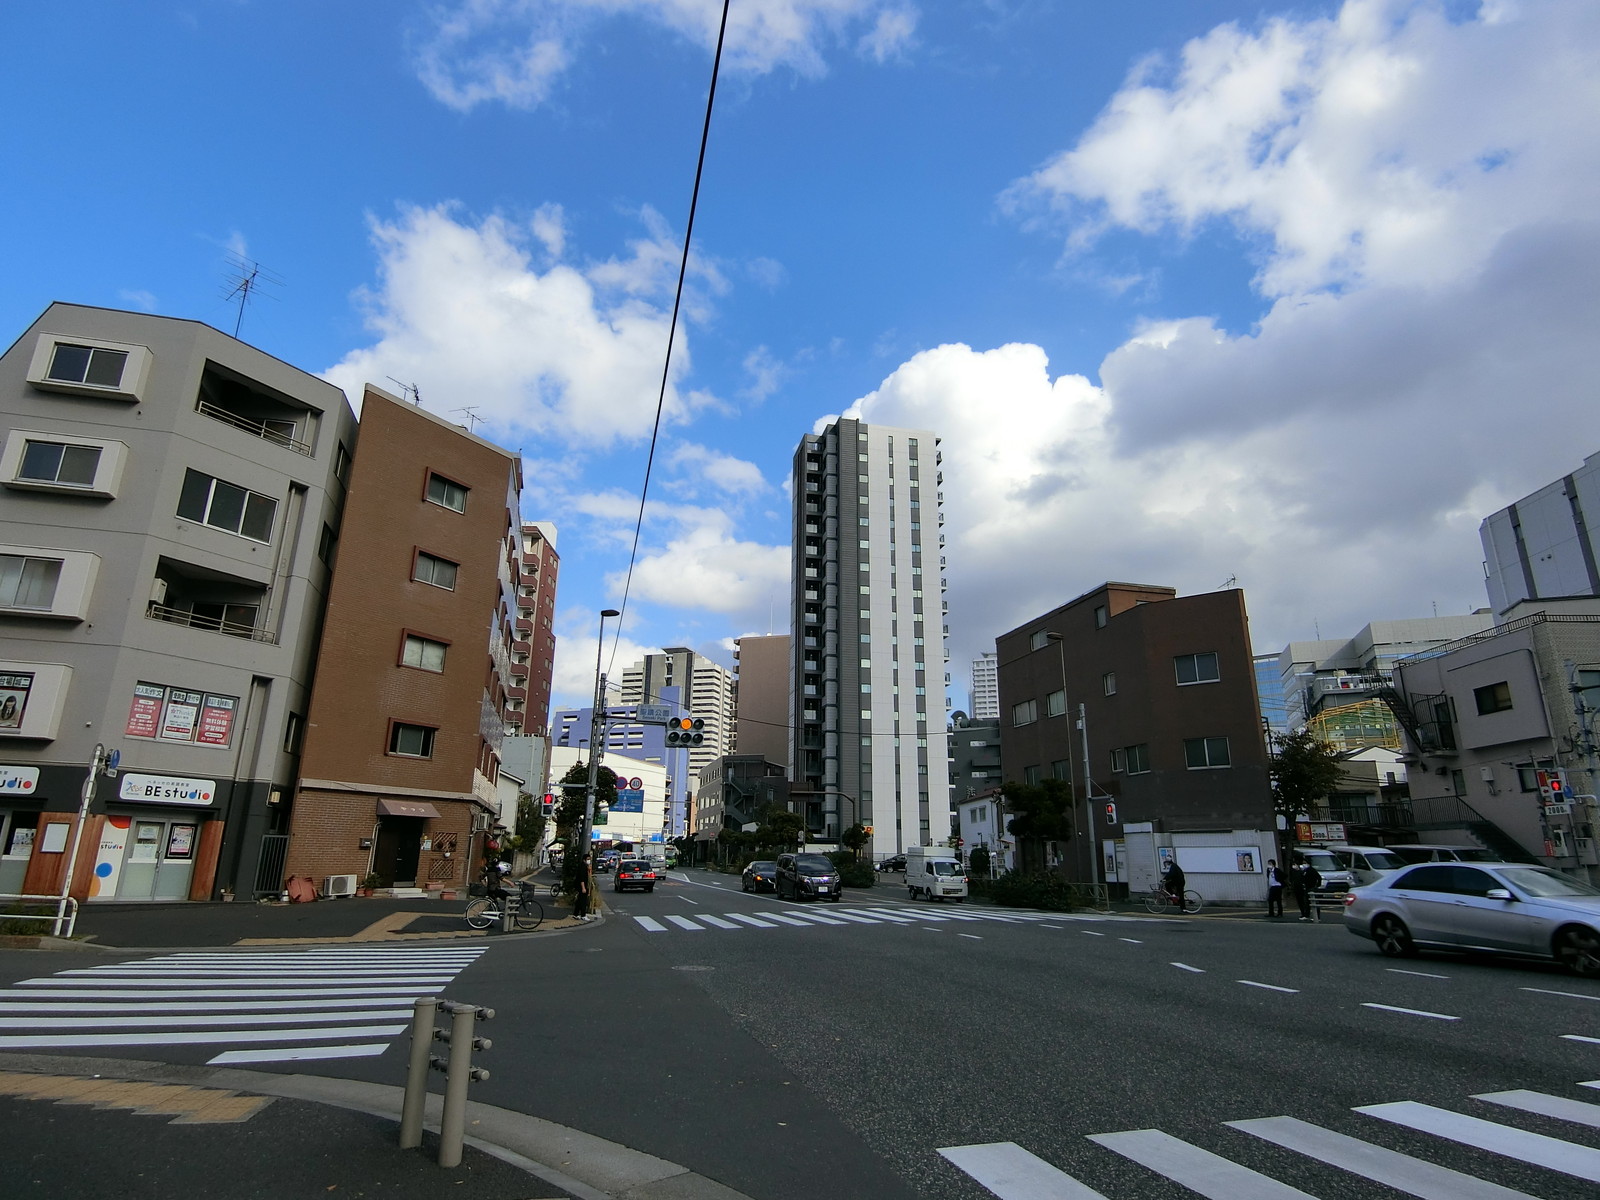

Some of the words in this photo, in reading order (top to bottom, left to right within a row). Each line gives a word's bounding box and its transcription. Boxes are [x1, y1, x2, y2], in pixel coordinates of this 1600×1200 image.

[632, 780, 641, 788] 40
[144, 785, 162, 797] BE
[164, 786, 210, 801] studio
